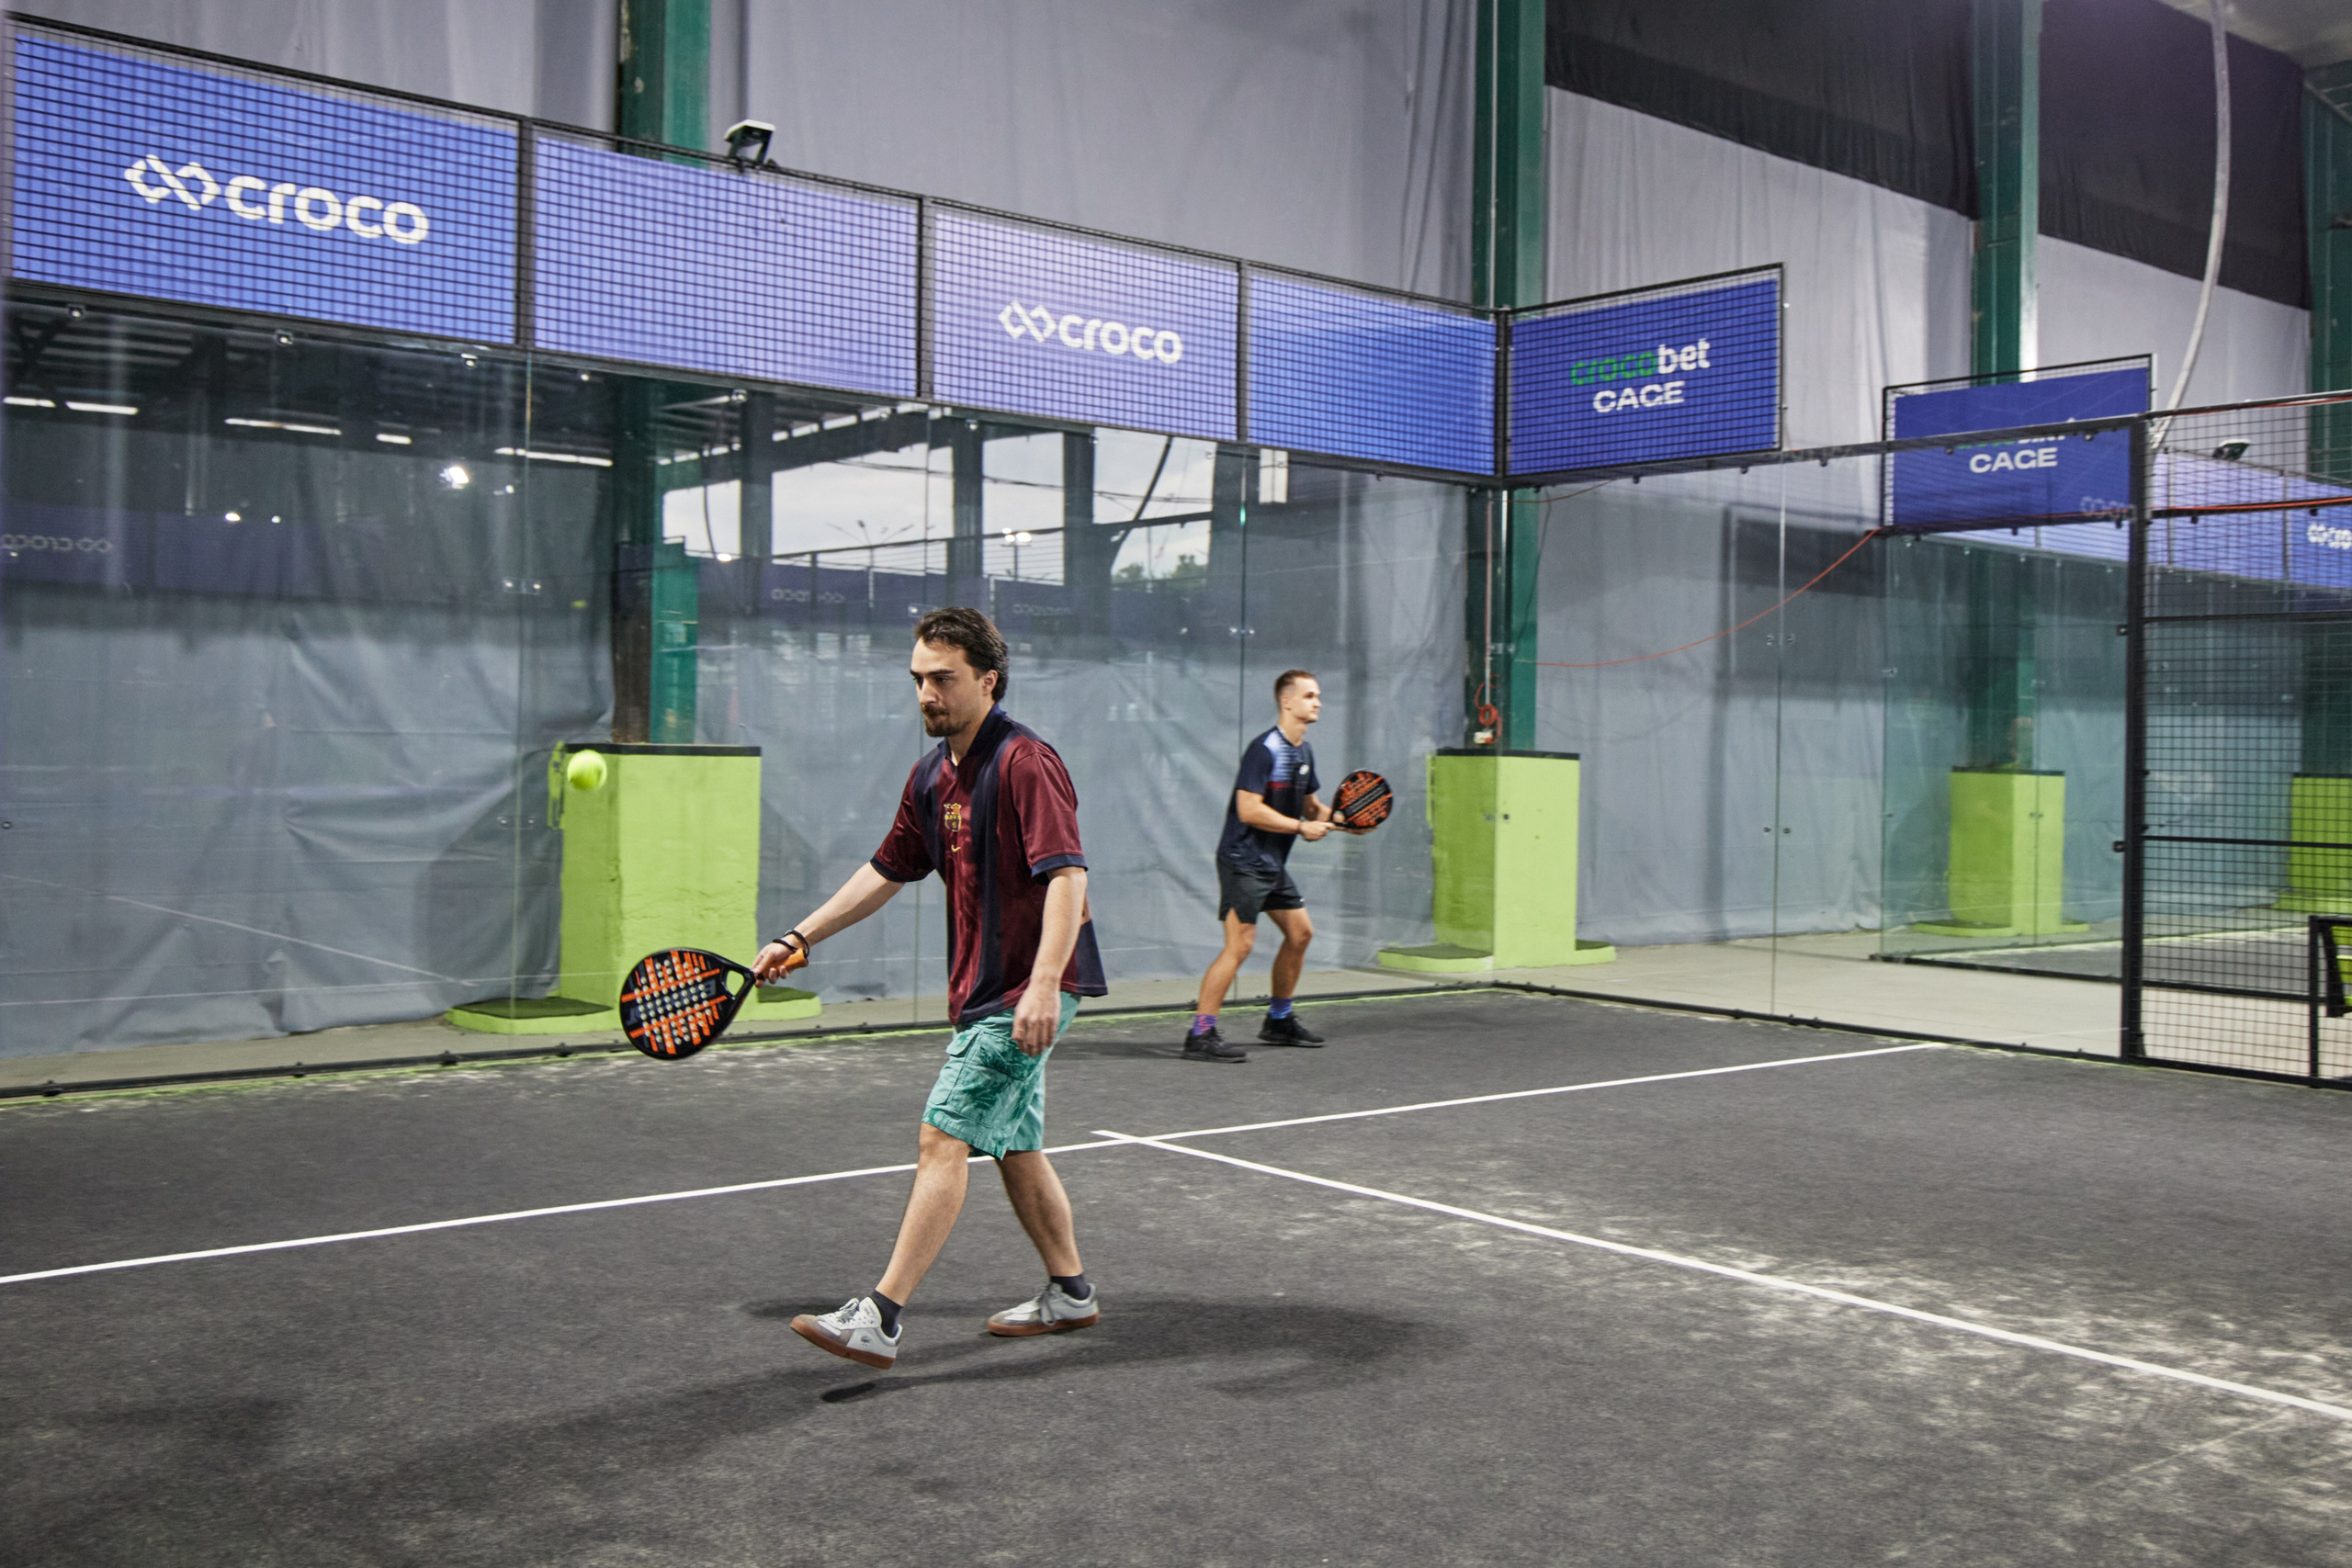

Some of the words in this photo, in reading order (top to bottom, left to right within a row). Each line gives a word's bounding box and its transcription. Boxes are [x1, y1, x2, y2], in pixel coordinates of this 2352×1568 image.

[225, 175, 429, 244] croco
[1058, 314, 1183, 364] croco
[1570, 338, 1711, 385] crocobet
